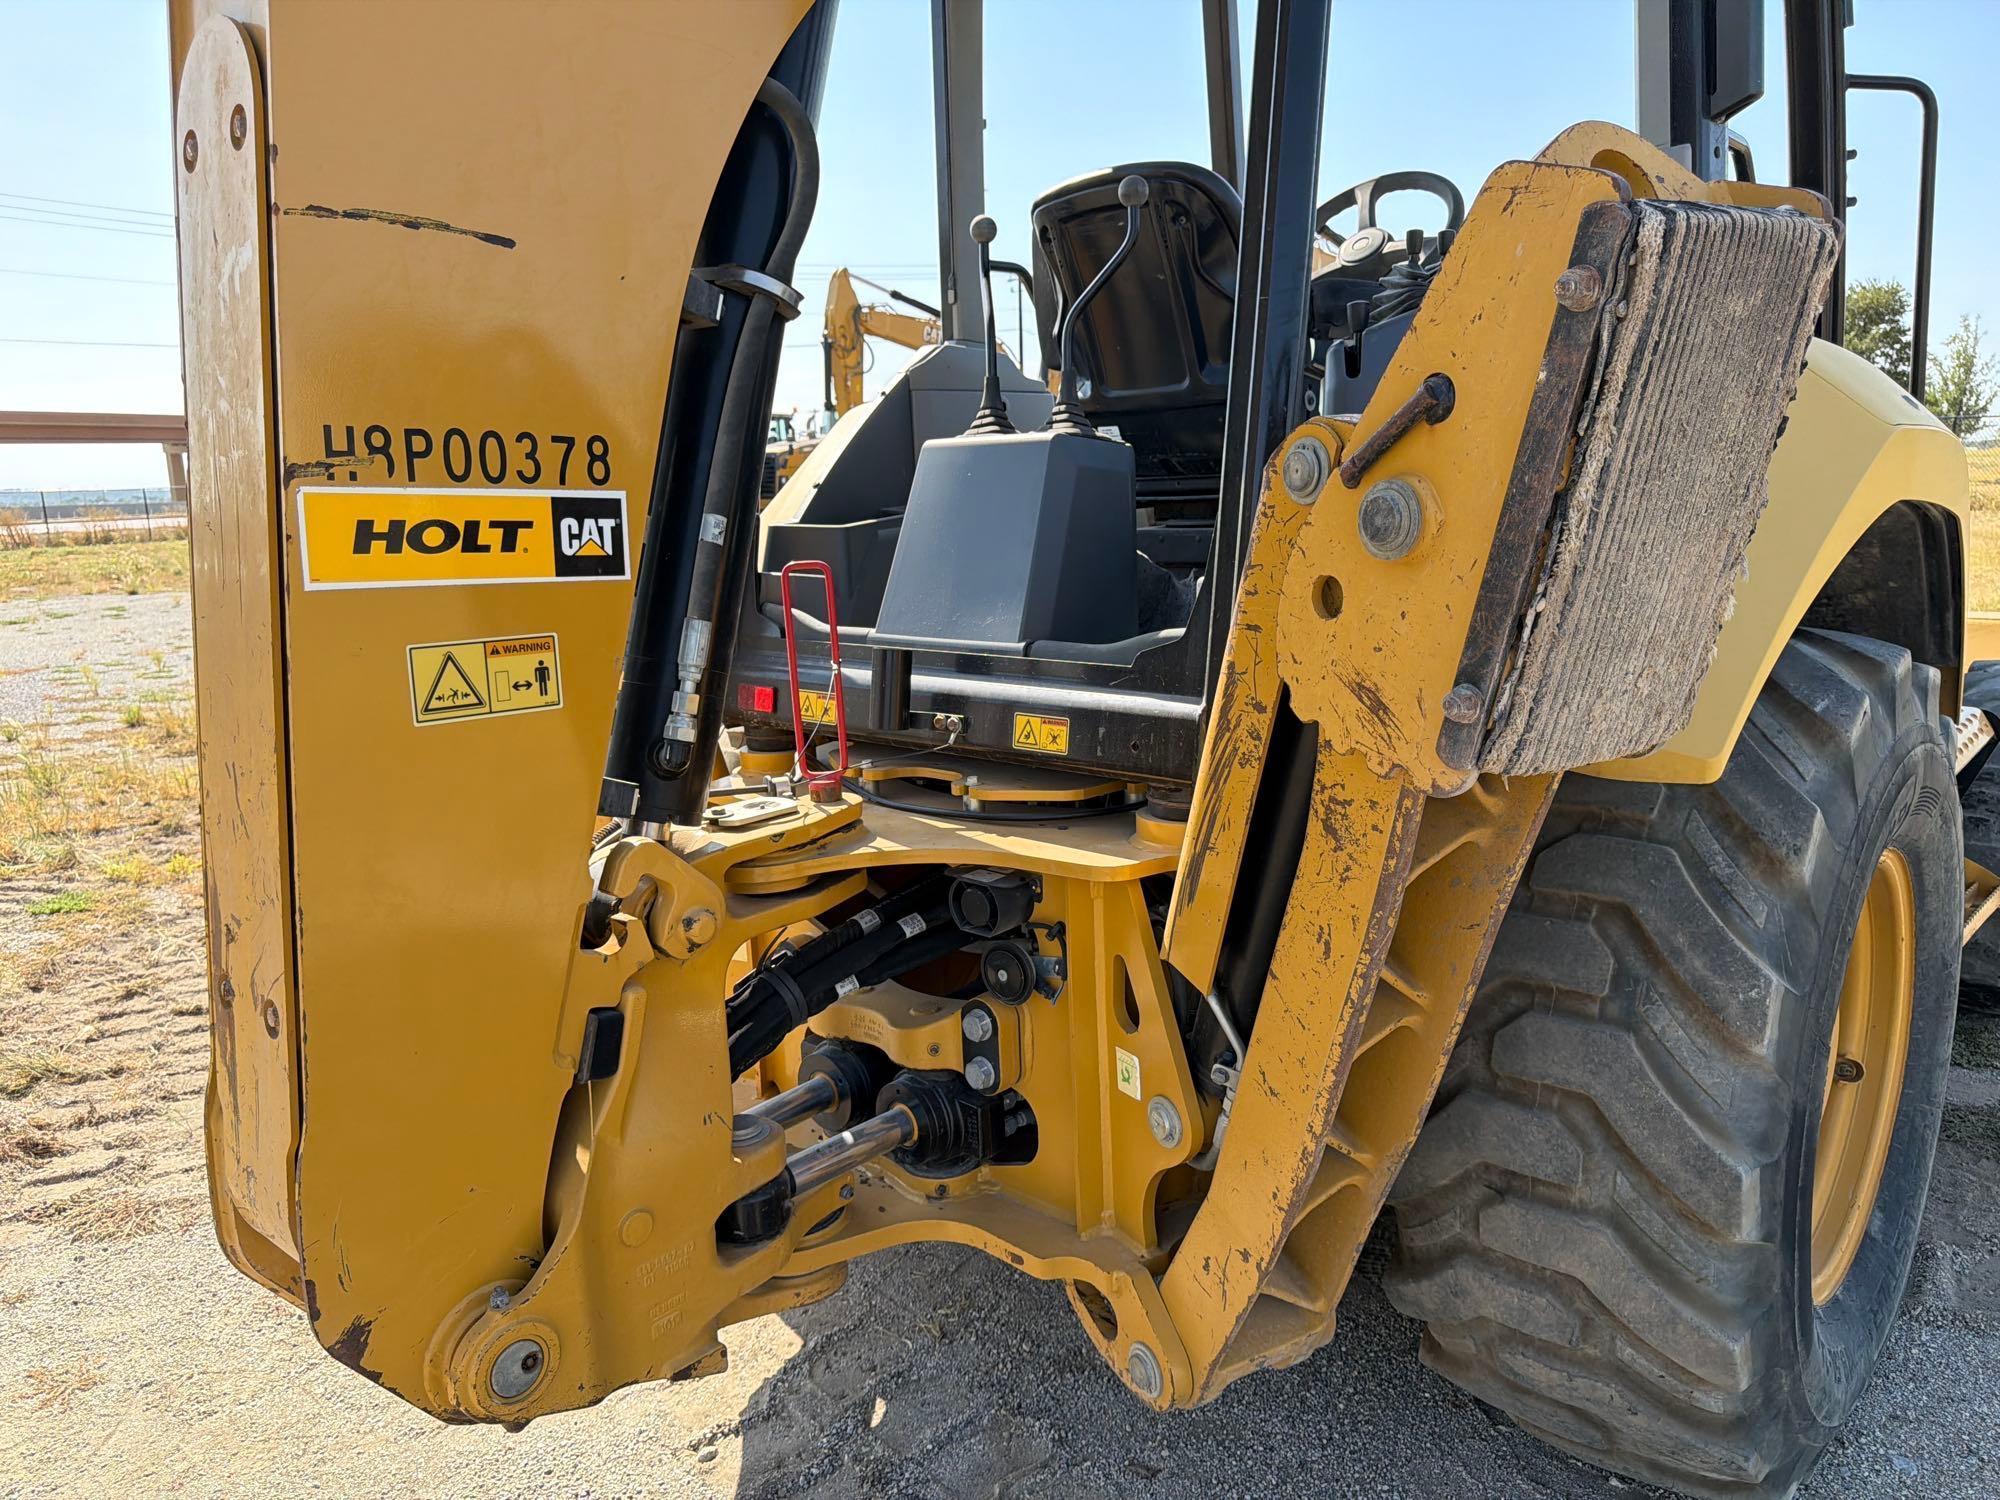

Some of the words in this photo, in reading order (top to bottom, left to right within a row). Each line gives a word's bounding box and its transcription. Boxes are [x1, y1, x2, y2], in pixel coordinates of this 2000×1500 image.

[352, 519, 534, 554] HOLT
[560, 517, 616, 556] CAT
[502, 641, 551, 654] WARNING
